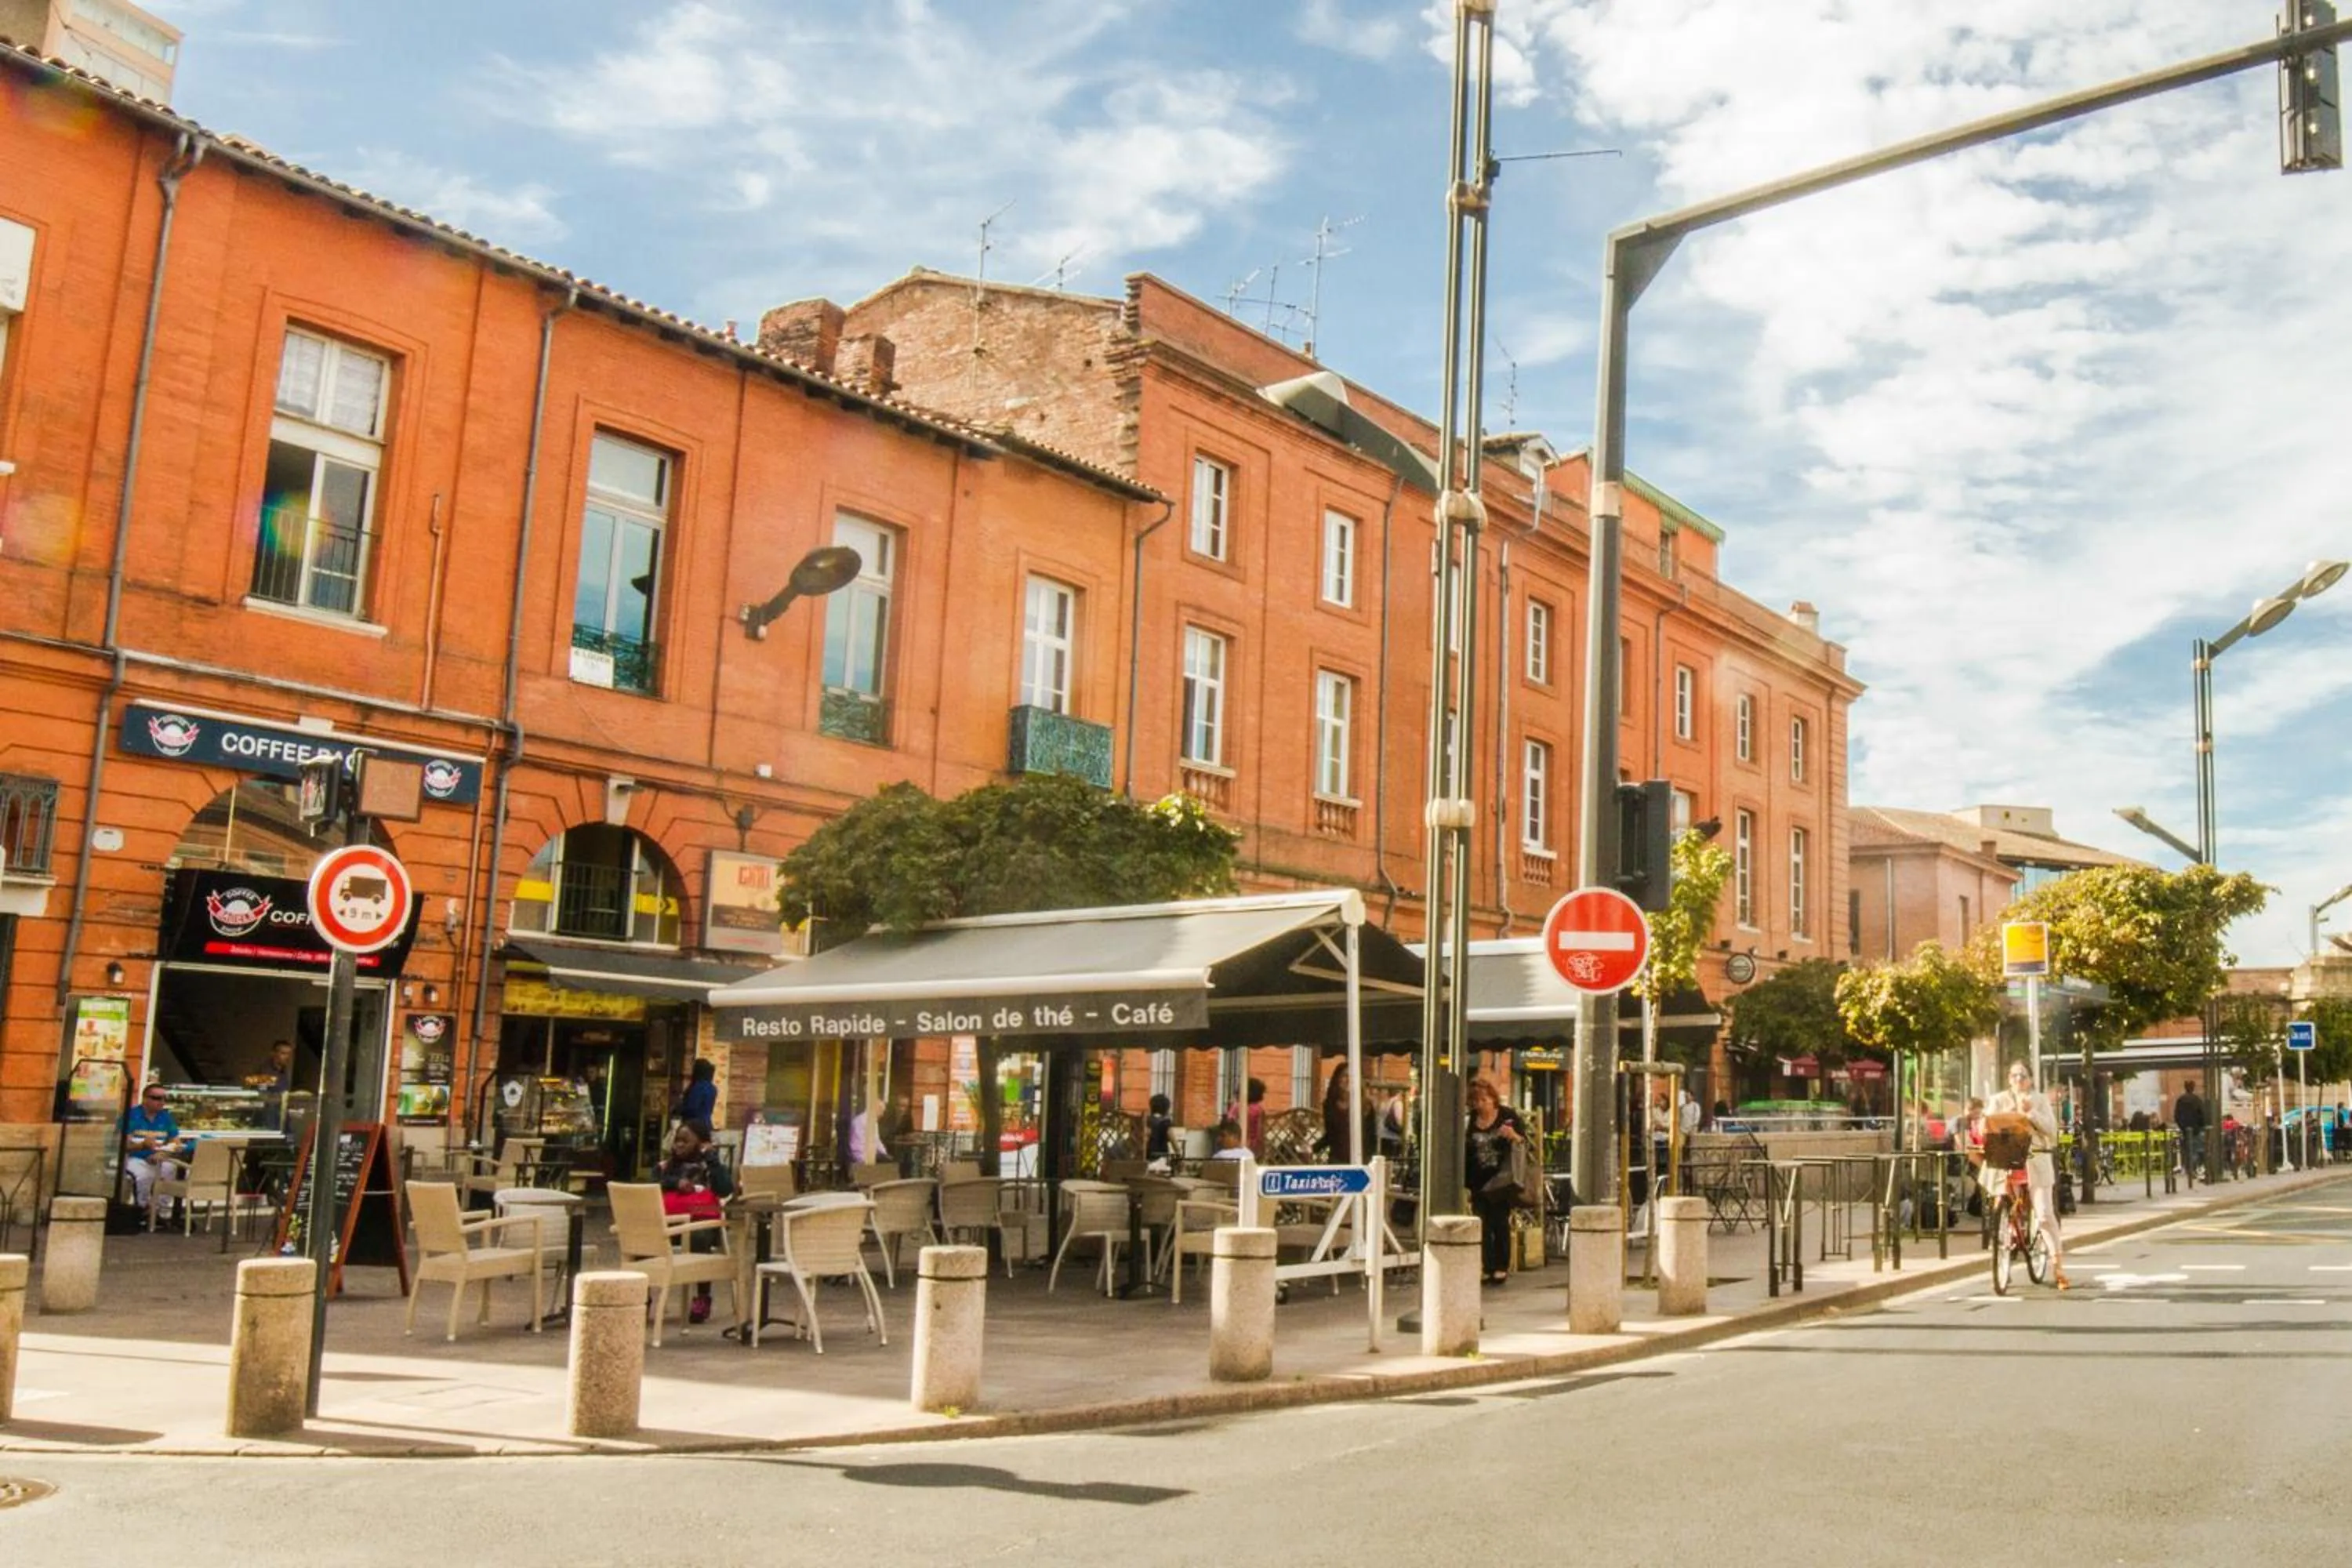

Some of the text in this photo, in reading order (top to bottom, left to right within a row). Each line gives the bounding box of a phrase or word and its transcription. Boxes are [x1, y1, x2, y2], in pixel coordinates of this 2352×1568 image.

[221, 732, 311, 764] COFFEE
[270, 910, 313, 925] COFF
[742, 1017, 802, 1036] Resto
[810, 1014, 886, 1036] Rapide
[916, 1011, 982, 1033] Salon
[993, 1007, 1023, 1029] de
[1033, 1005, 1074, 1026] thé
[1112, 1002, 1174, 1025] Café
[1284, 1174, 1318, 1190] Taxis
